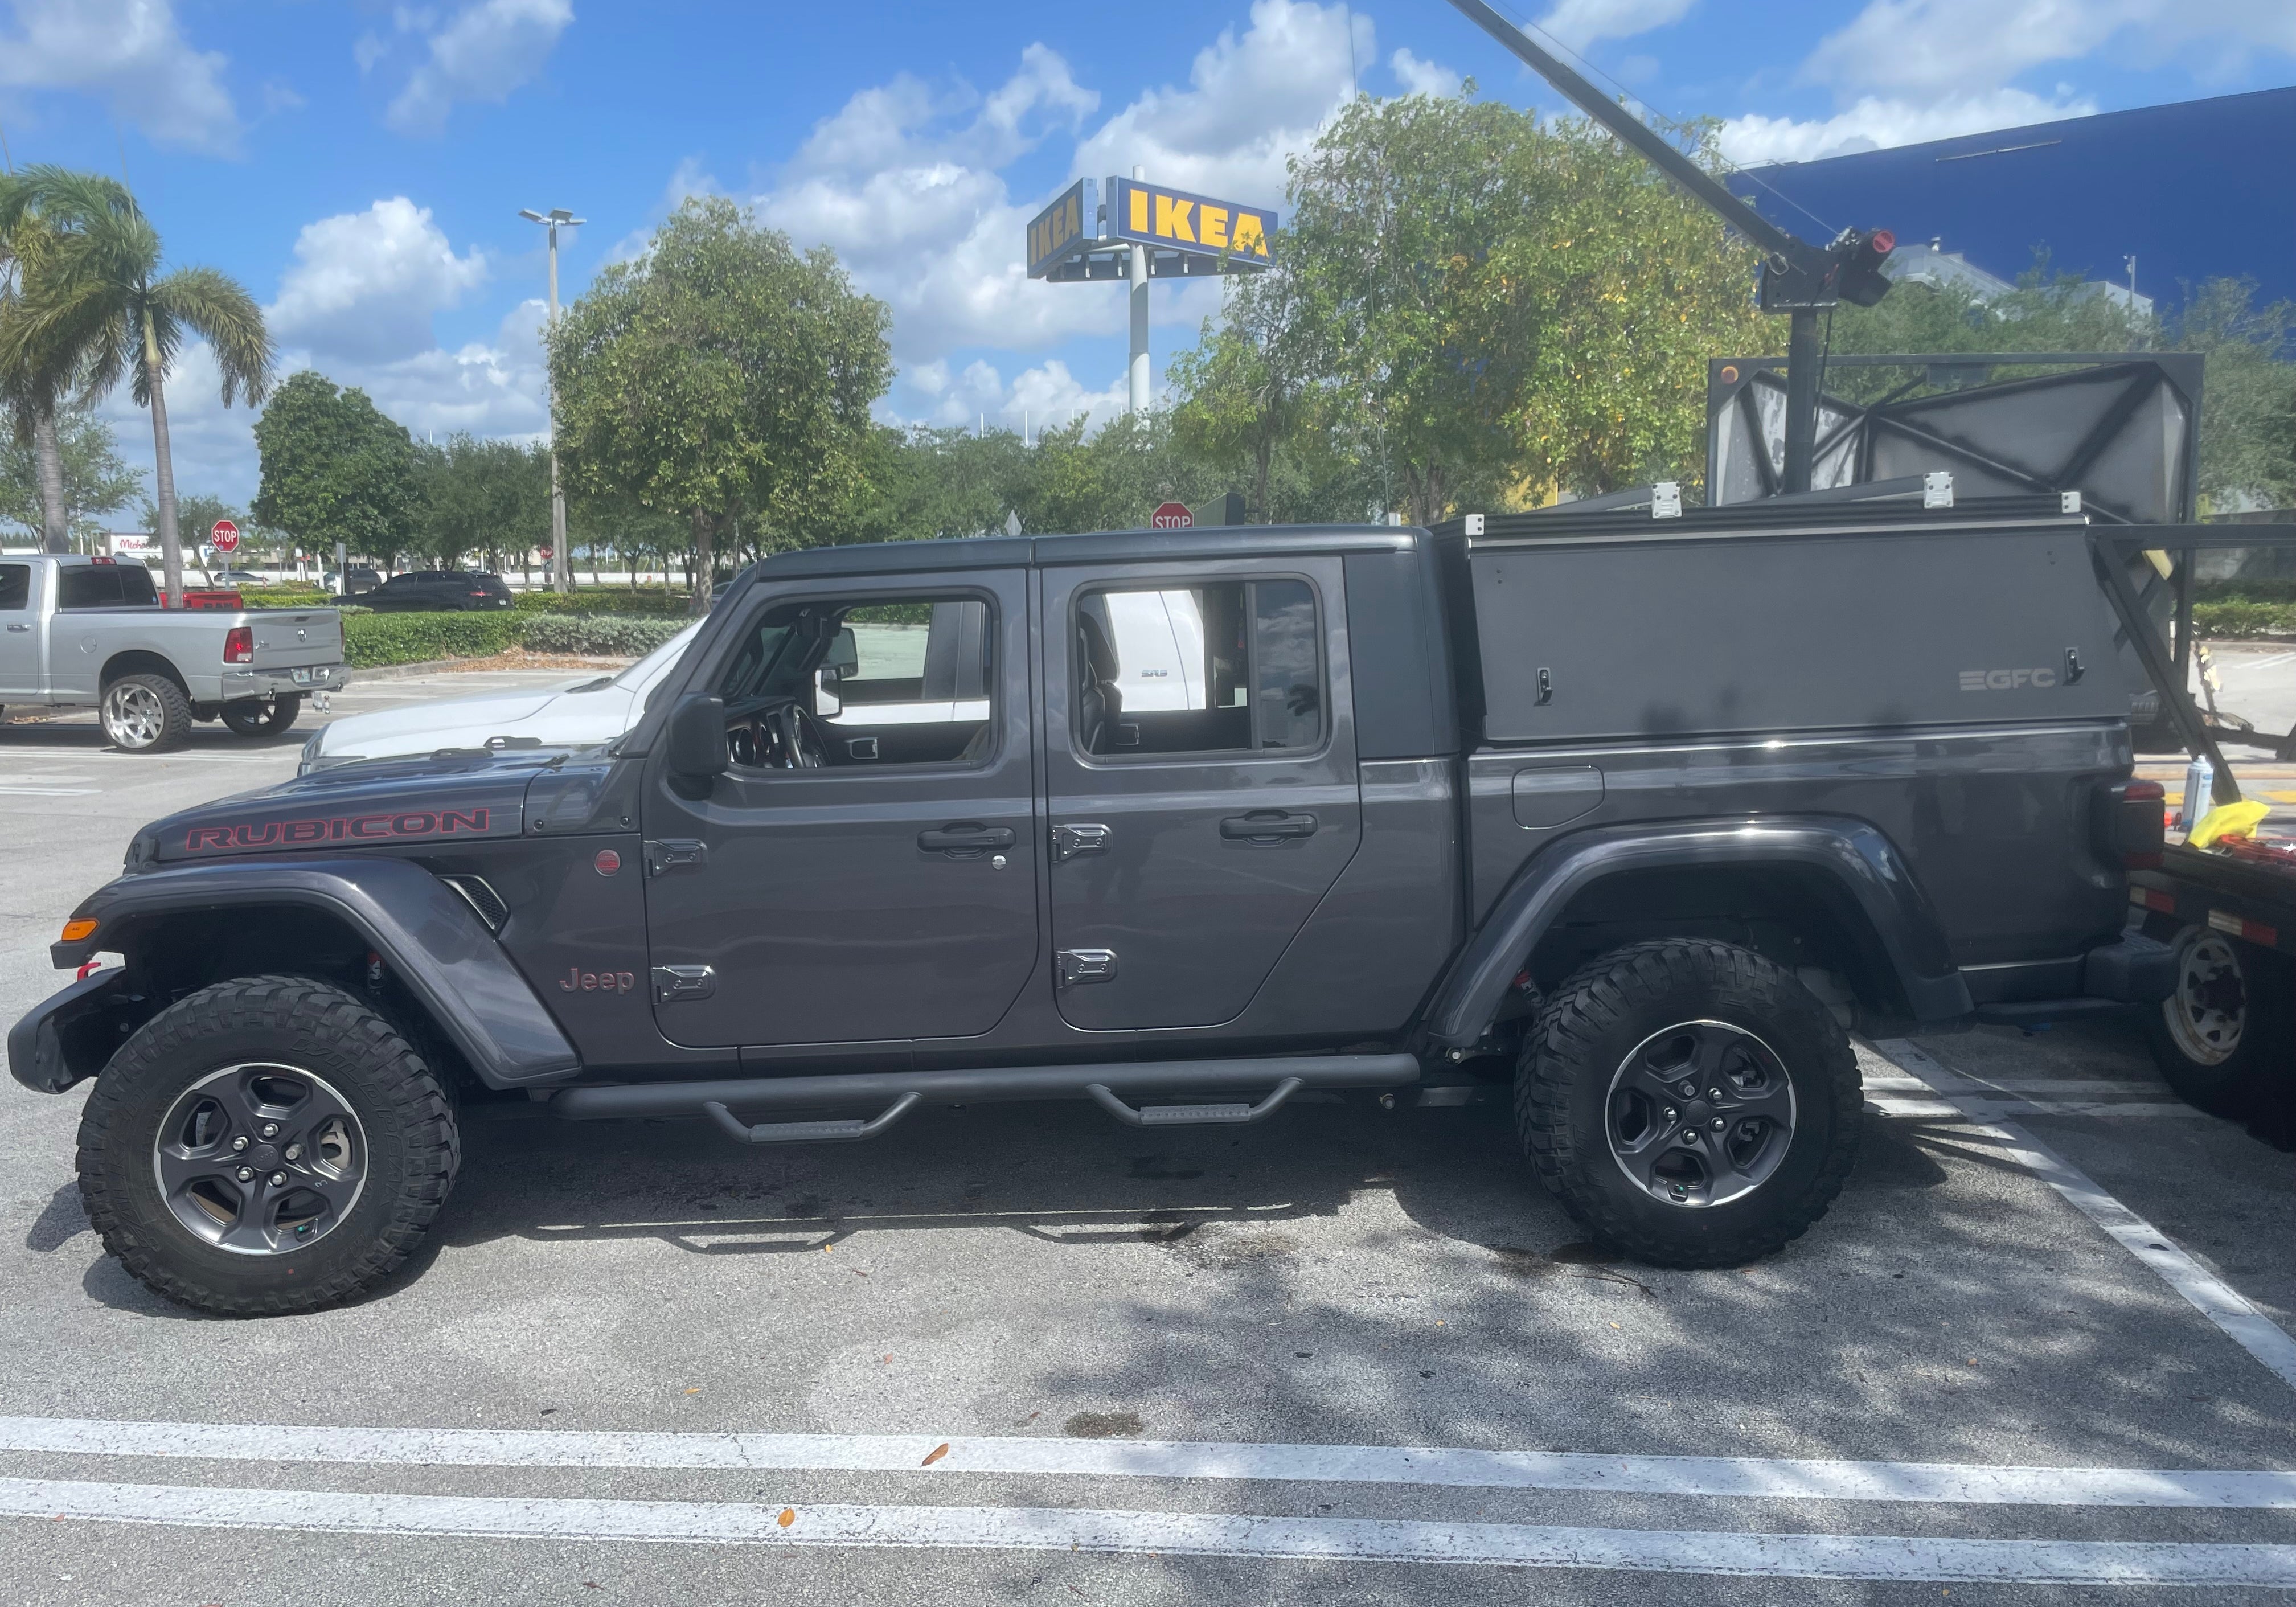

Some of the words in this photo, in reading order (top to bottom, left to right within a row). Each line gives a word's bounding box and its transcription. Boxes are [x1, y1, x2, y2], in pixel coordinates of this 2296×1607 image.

[1031, 194, 1080, 266] IKEA
[1130, 188, 1269, 257] IKEA
[214, 530, 237, 542] STOP
[1155, 515, 1191, 528] STOP
[186, 809, 490, 851] RUBICON
[559, 968, 634, 995] Jeep
